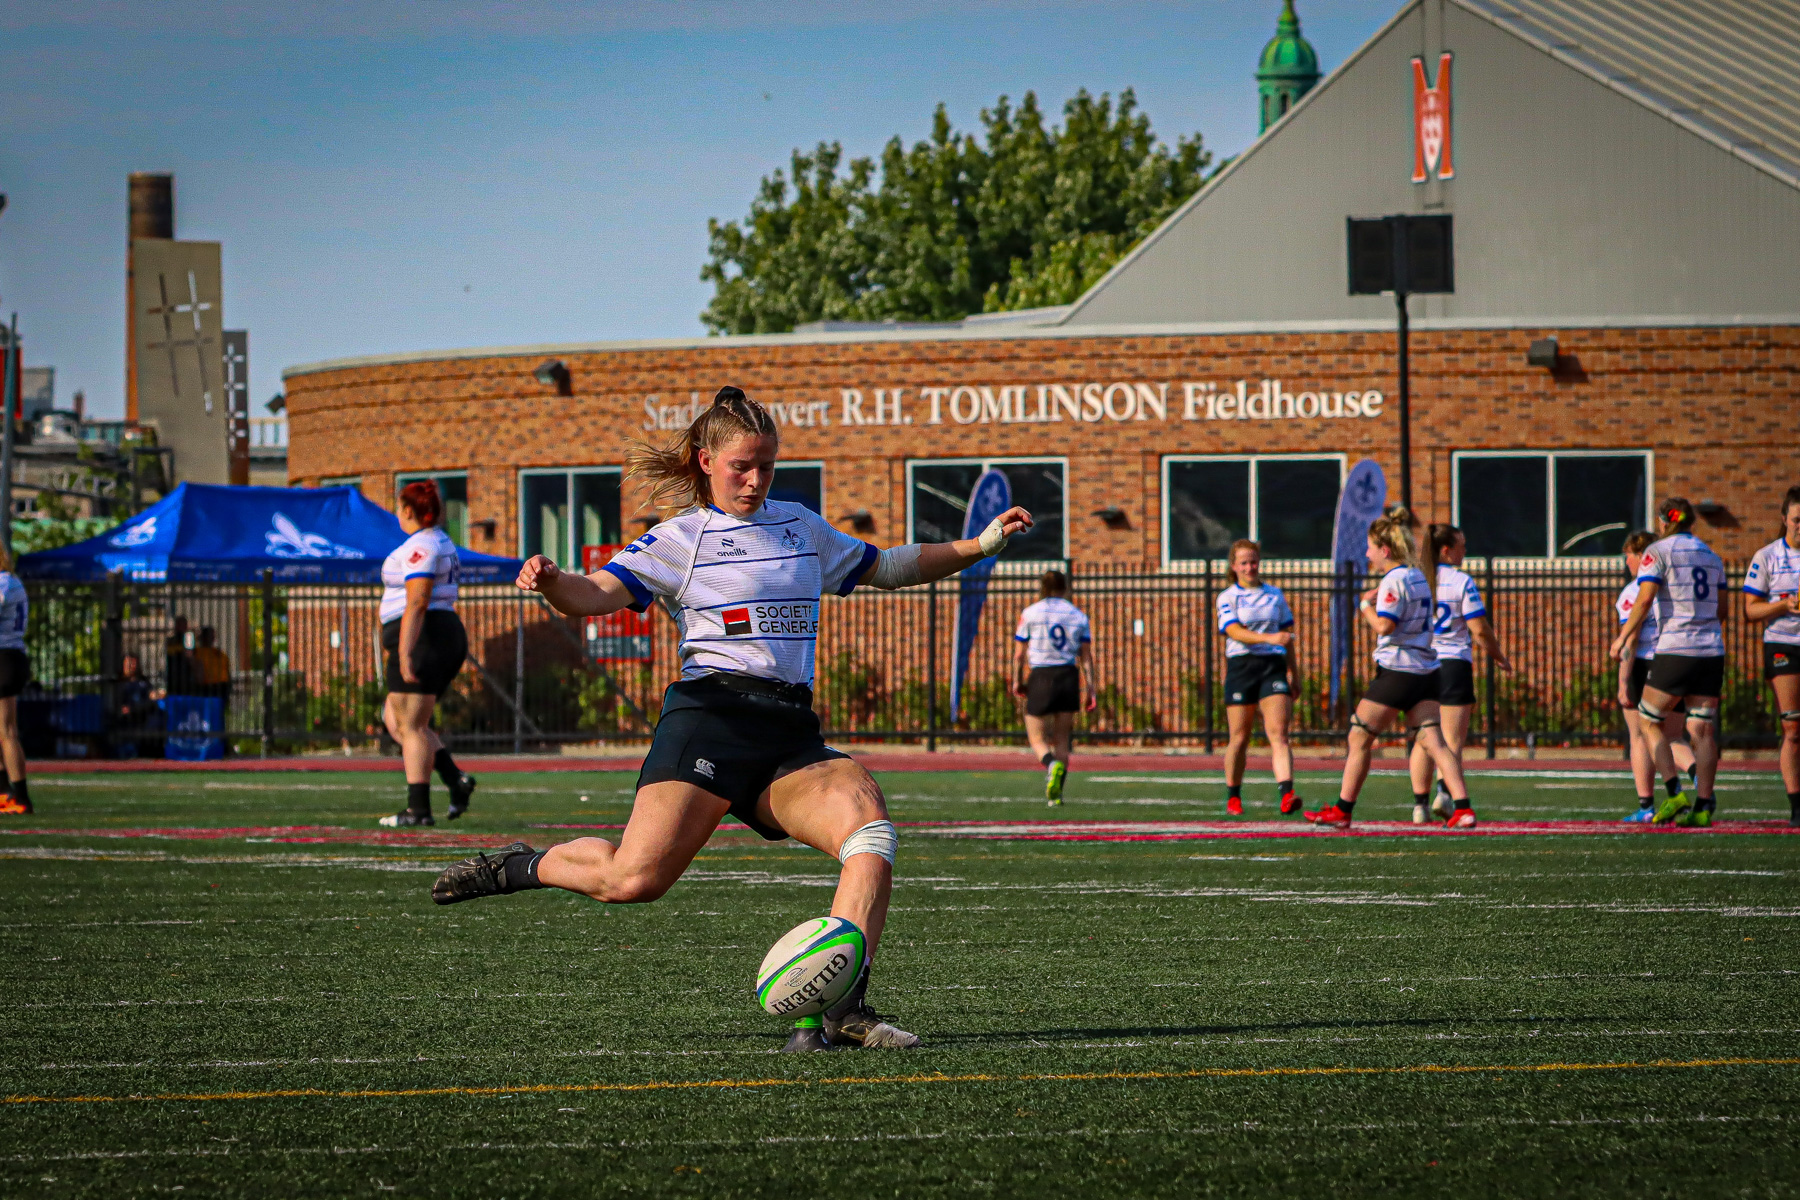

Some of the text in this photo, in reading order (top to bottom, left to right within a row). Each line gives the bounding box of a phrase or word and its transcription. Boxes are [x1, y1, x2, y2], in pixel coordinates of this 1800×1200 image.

[841, 387, 914, 426] R.H.
[920, 381, 1171, 424] TOMLINSON
[1182, 378, 1384, 421] Fieldhouse
[716, 547, 748, 558] oneills
[1691, 566, 1710, 600] 8
[1420, 598, 1431, 632] 7
[1434, 601, 1452, 634] 2
[1049, 623, 1066, 651] 9
[770, 953, 848, 1016] GILBERT
